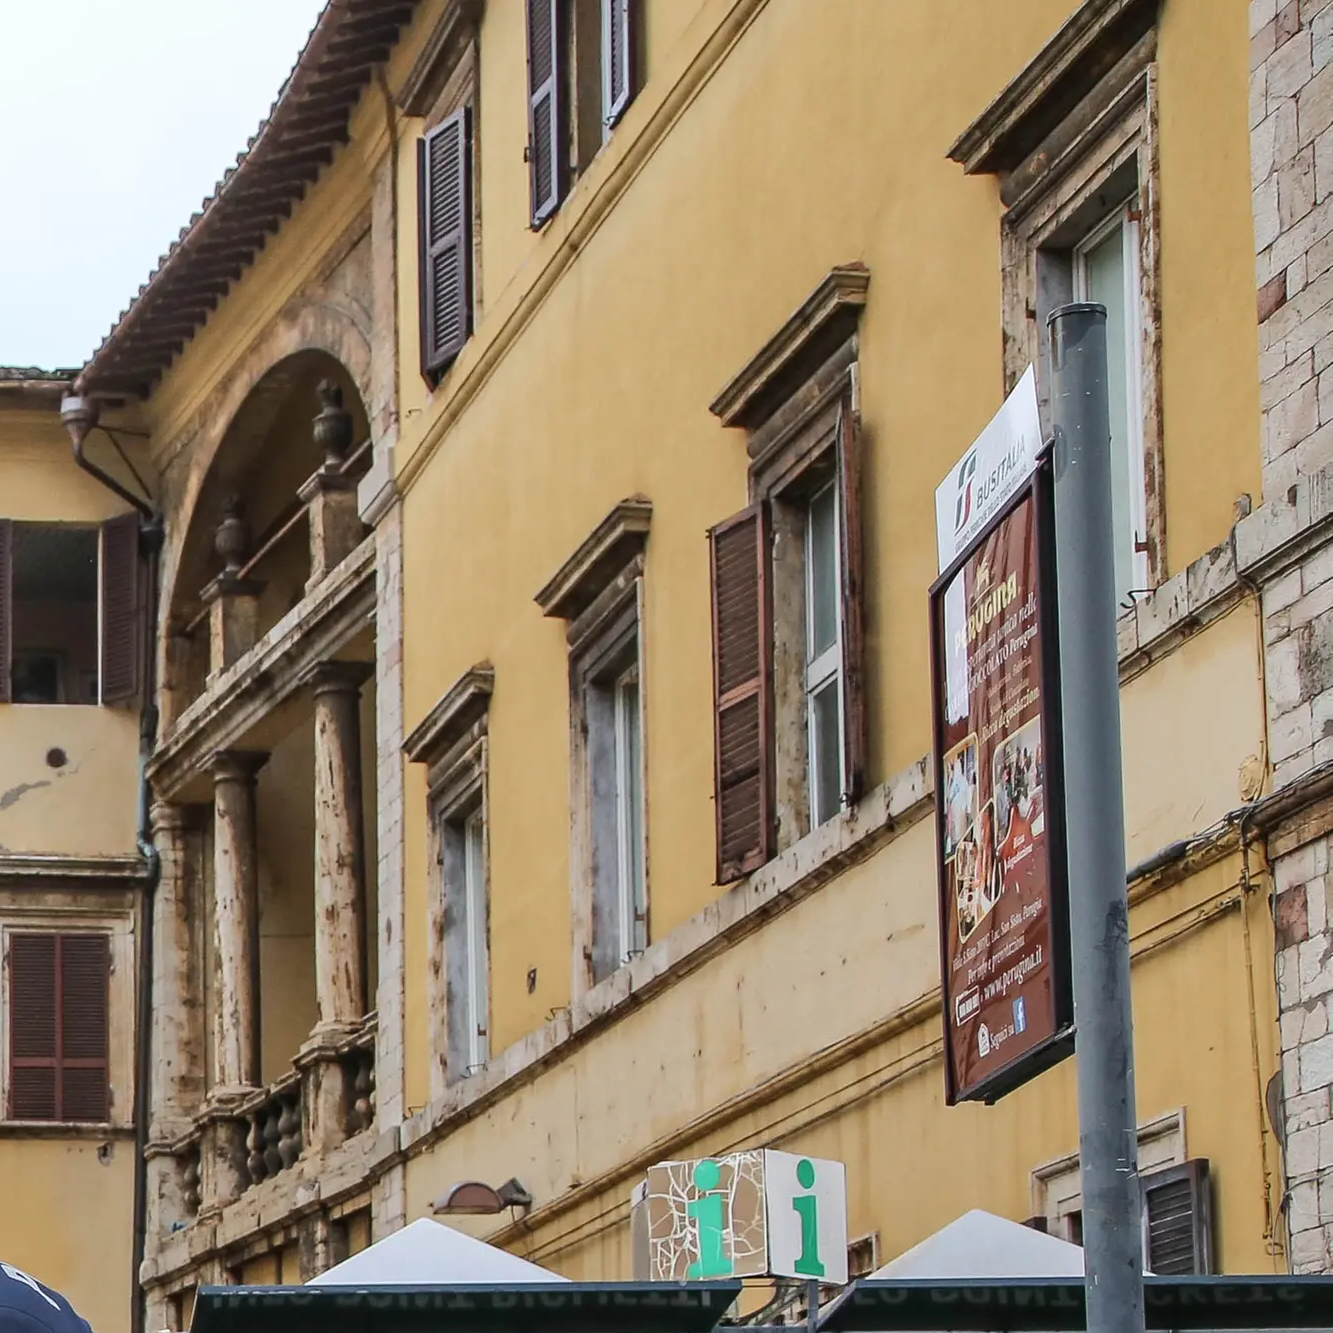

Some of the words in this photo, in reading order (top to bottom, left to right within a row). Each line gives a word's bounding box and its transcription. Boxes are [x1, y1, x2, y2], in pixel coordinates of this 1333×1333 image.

[975, 434, 1026, 510] BUSITALIA
[953, 570, 1017, 660] PERUGINA
[984, 944, 1042, 1000] www.perugina.it
